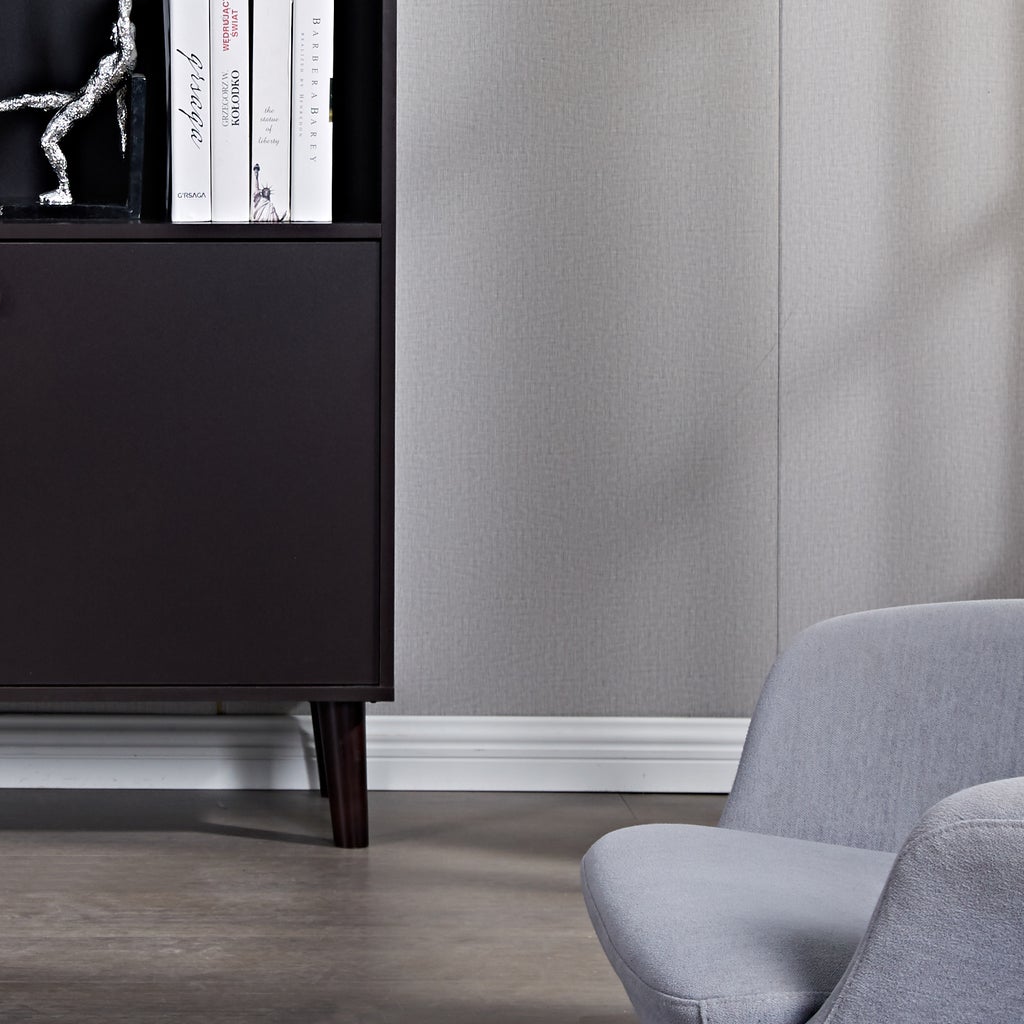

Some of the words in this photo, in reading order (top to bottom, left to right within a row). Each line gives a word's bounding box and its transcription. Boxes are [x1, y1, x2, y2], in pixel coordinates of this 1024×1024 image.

[311, 18, 321, 99] BARBERA
[231, 70, 240, 126] KOŁODKO
[258, 136, 280, 146] liberty
[265, 124, 272, 134] of
[309, 107, 319, 162] BAREY
